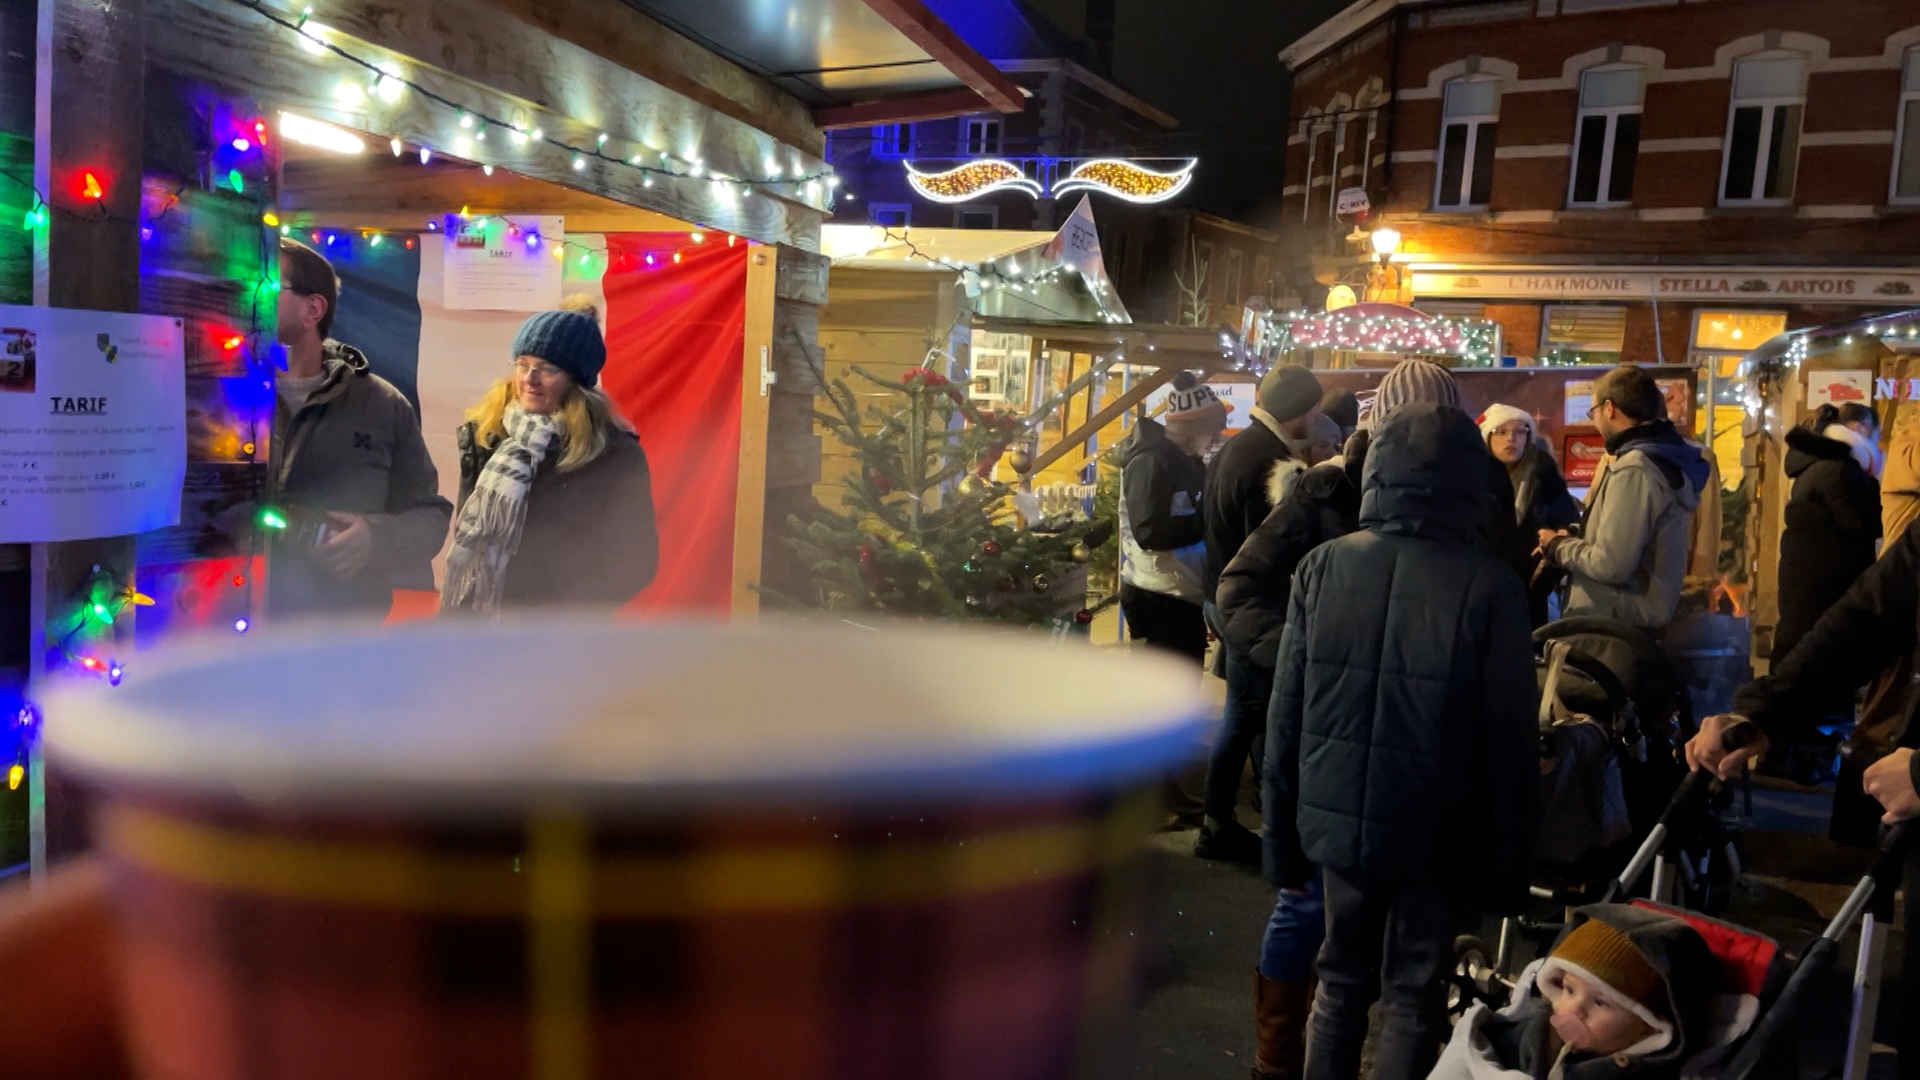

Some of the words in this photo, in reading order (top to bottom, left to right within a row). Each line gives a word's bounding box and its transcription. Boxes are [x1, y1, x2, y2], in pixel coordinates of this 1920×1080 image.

[1507, 276, 1632, 291] L'HARMONIE
[1658, 277, 1731, 292] STELLA
[1775, 278, 1856, 294] ARTOIS
[50, 396, 108, 415] TARIF
